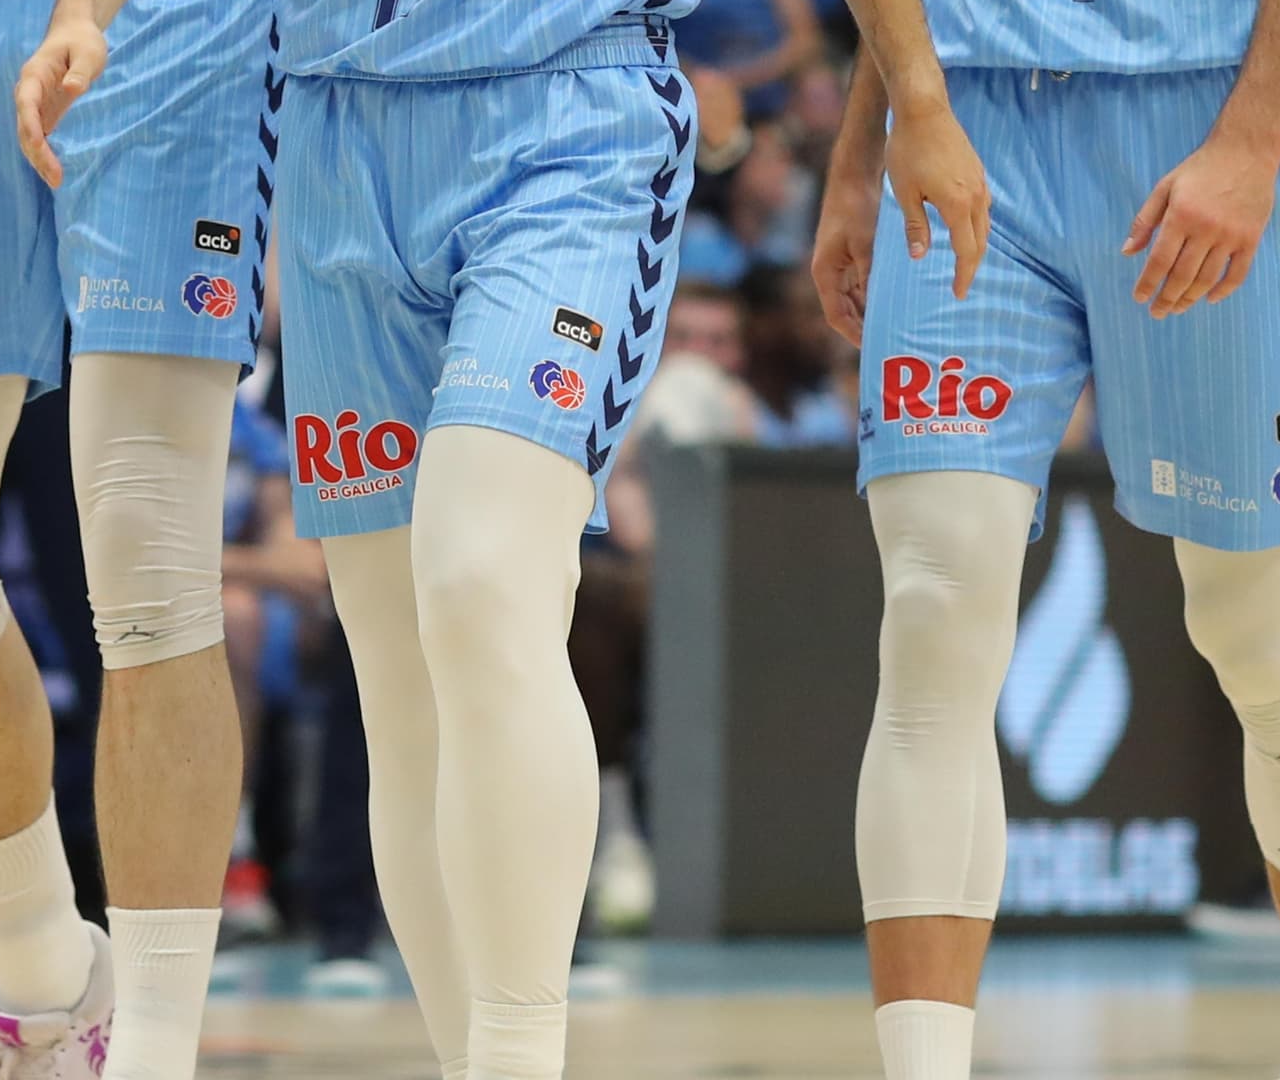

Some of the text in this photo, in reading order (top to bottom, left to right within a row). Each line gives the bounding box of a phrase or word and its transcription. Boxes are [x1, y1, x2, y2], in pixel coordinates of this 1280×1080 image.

[198, 229, 233, 252] acb
[100, 295, 165, 313] GALICIA
[557, 320, 593, 345] acb
[448, 374, 510, 392] GALICIA
[881, 355, 1013, 423] Río
[903, 421, 989, 437] DE GALICIA
[293, 410, 418, 484] Río
[318, 474, 403, 501] DE GALICIA
[1196, 491, 1258, 513] GALICIA
